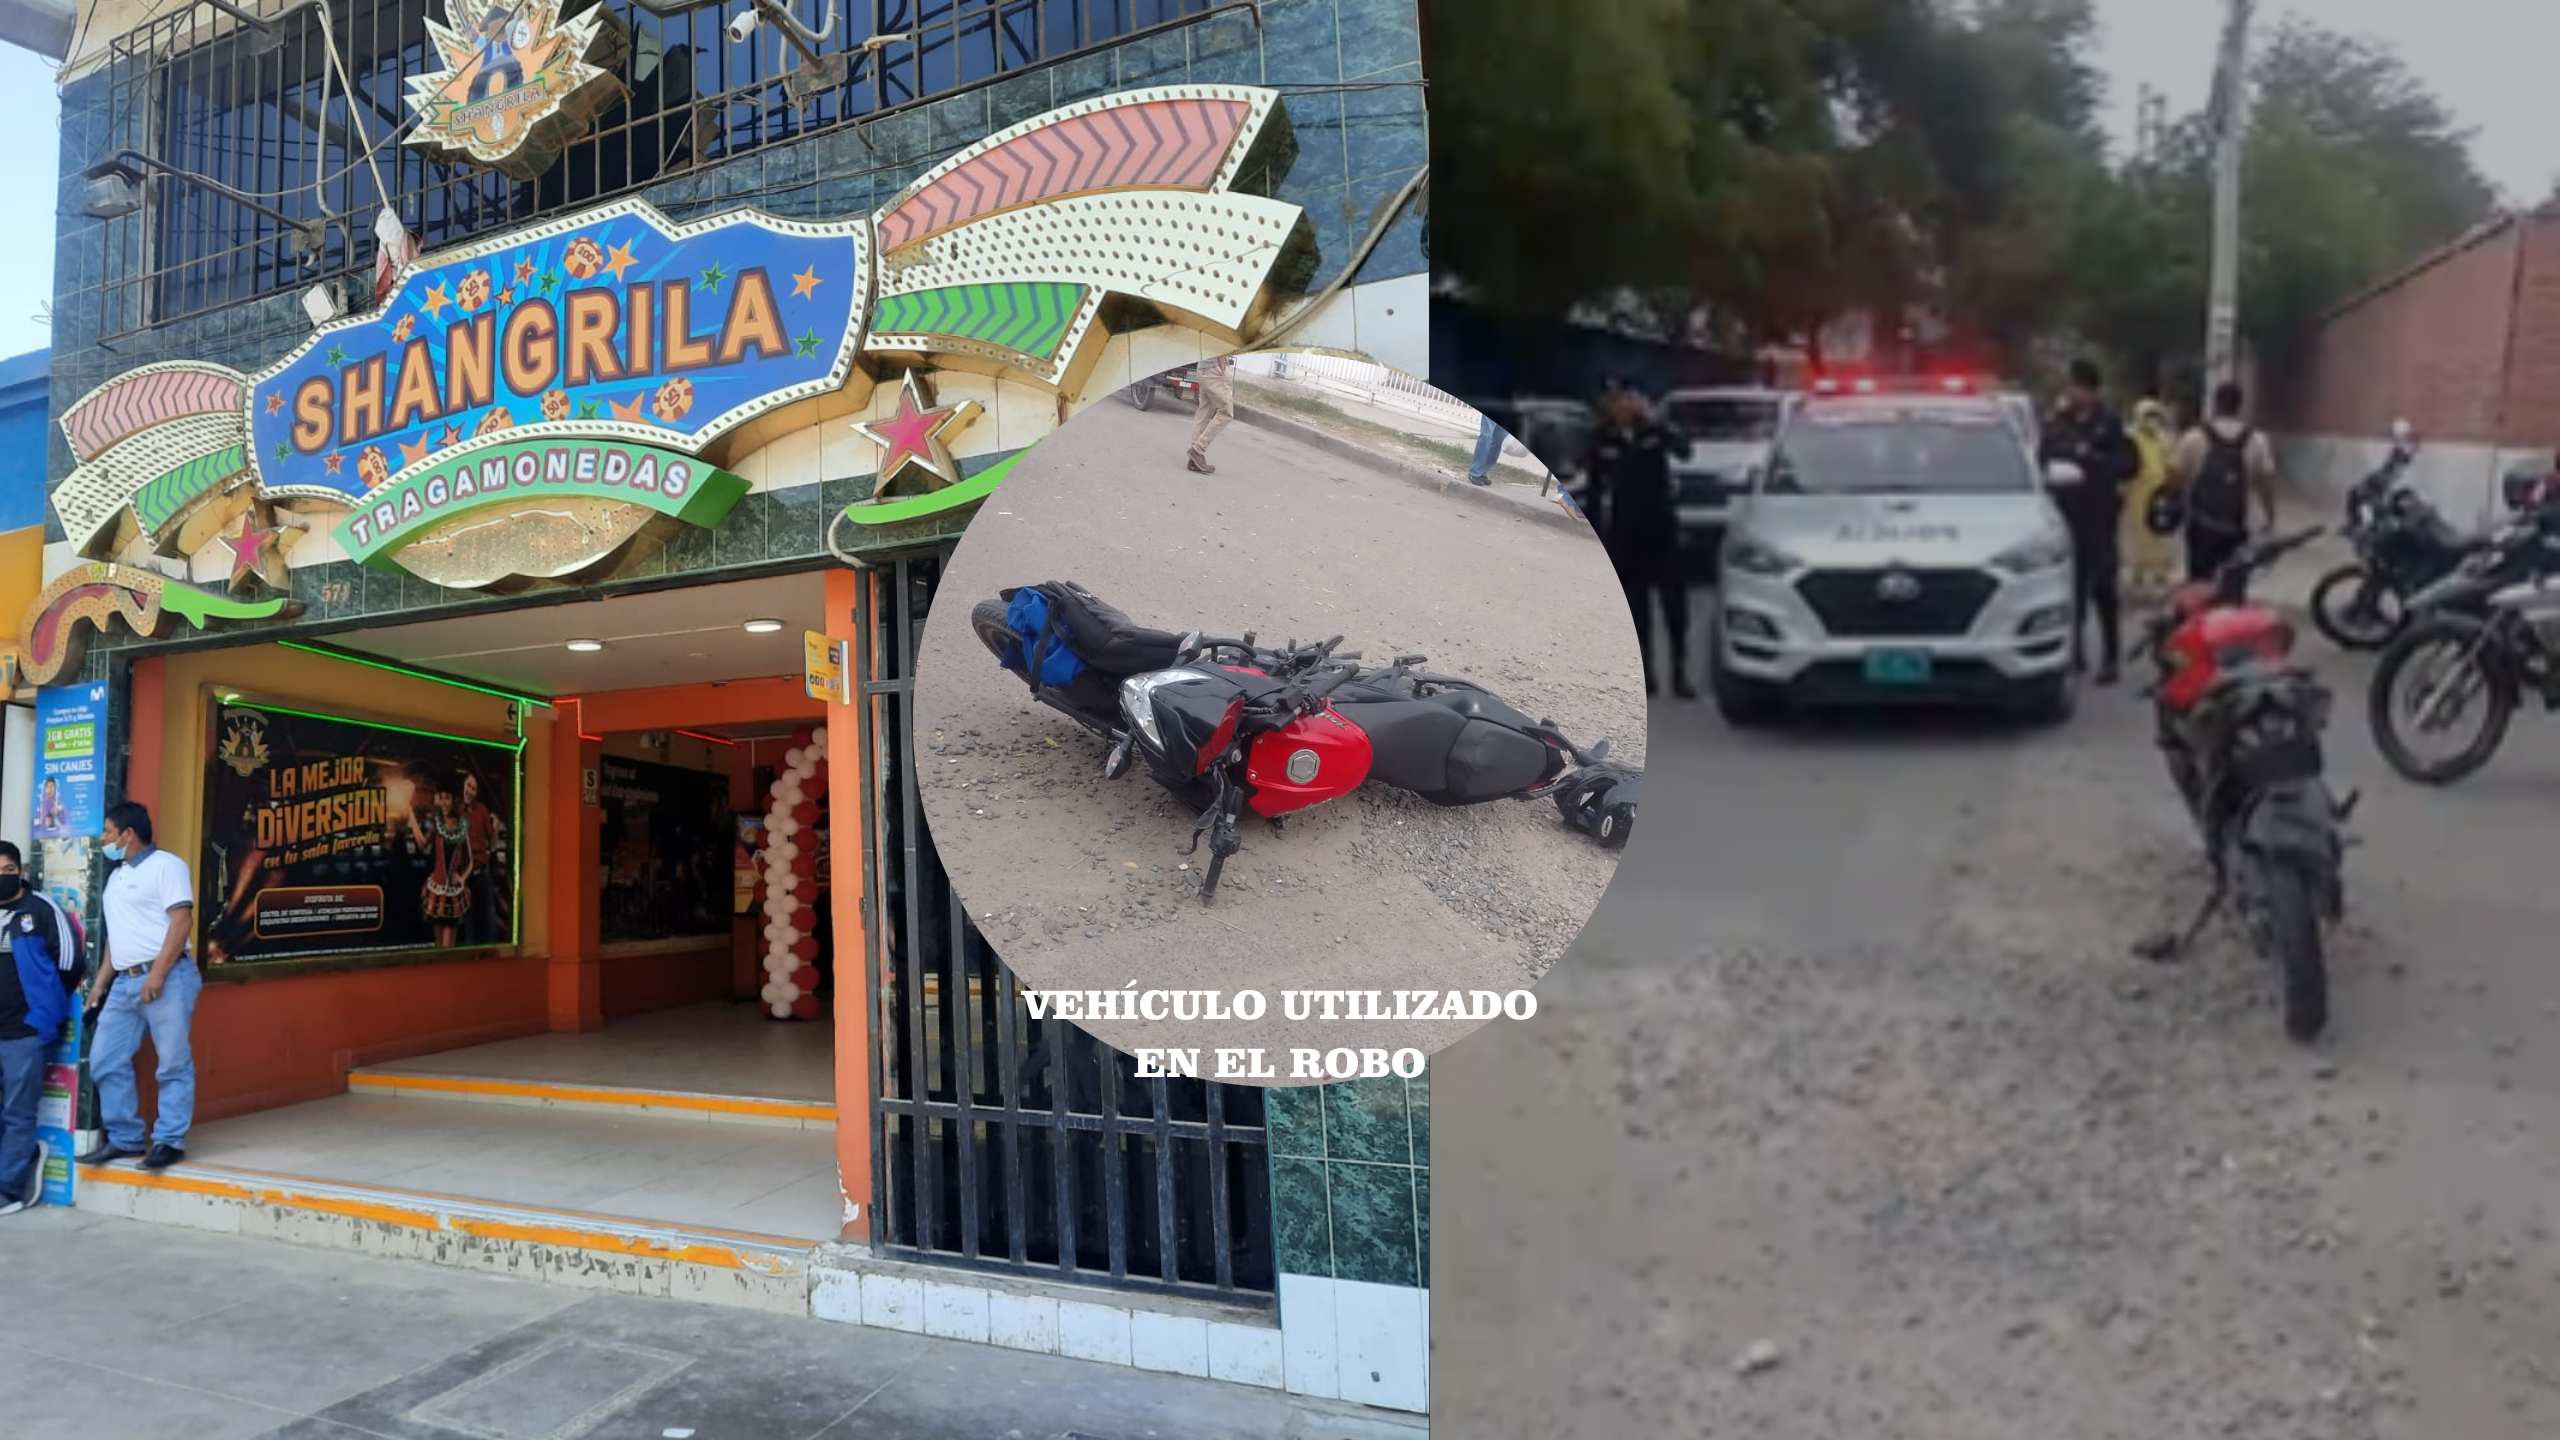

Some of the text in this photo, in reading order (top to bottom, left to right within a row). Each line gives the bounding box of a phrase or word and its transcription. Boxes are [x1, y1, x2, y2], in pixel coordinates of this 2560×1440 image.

[454, 87, 541, 126] SHANGRILA
[577, 245, 595, 263] 100
[292, 267, 792, 454] SHANGRILA
[350, 449, 693, 548] TRAGAMONEDAS
[64, 727, 92, 740] GRATIS
[45, 759, 93, 775] SIN CANJES
[270, 767, 296, 798] LA
[586, 771, 595, 788] S
[302, 842, 329, 860] sala
